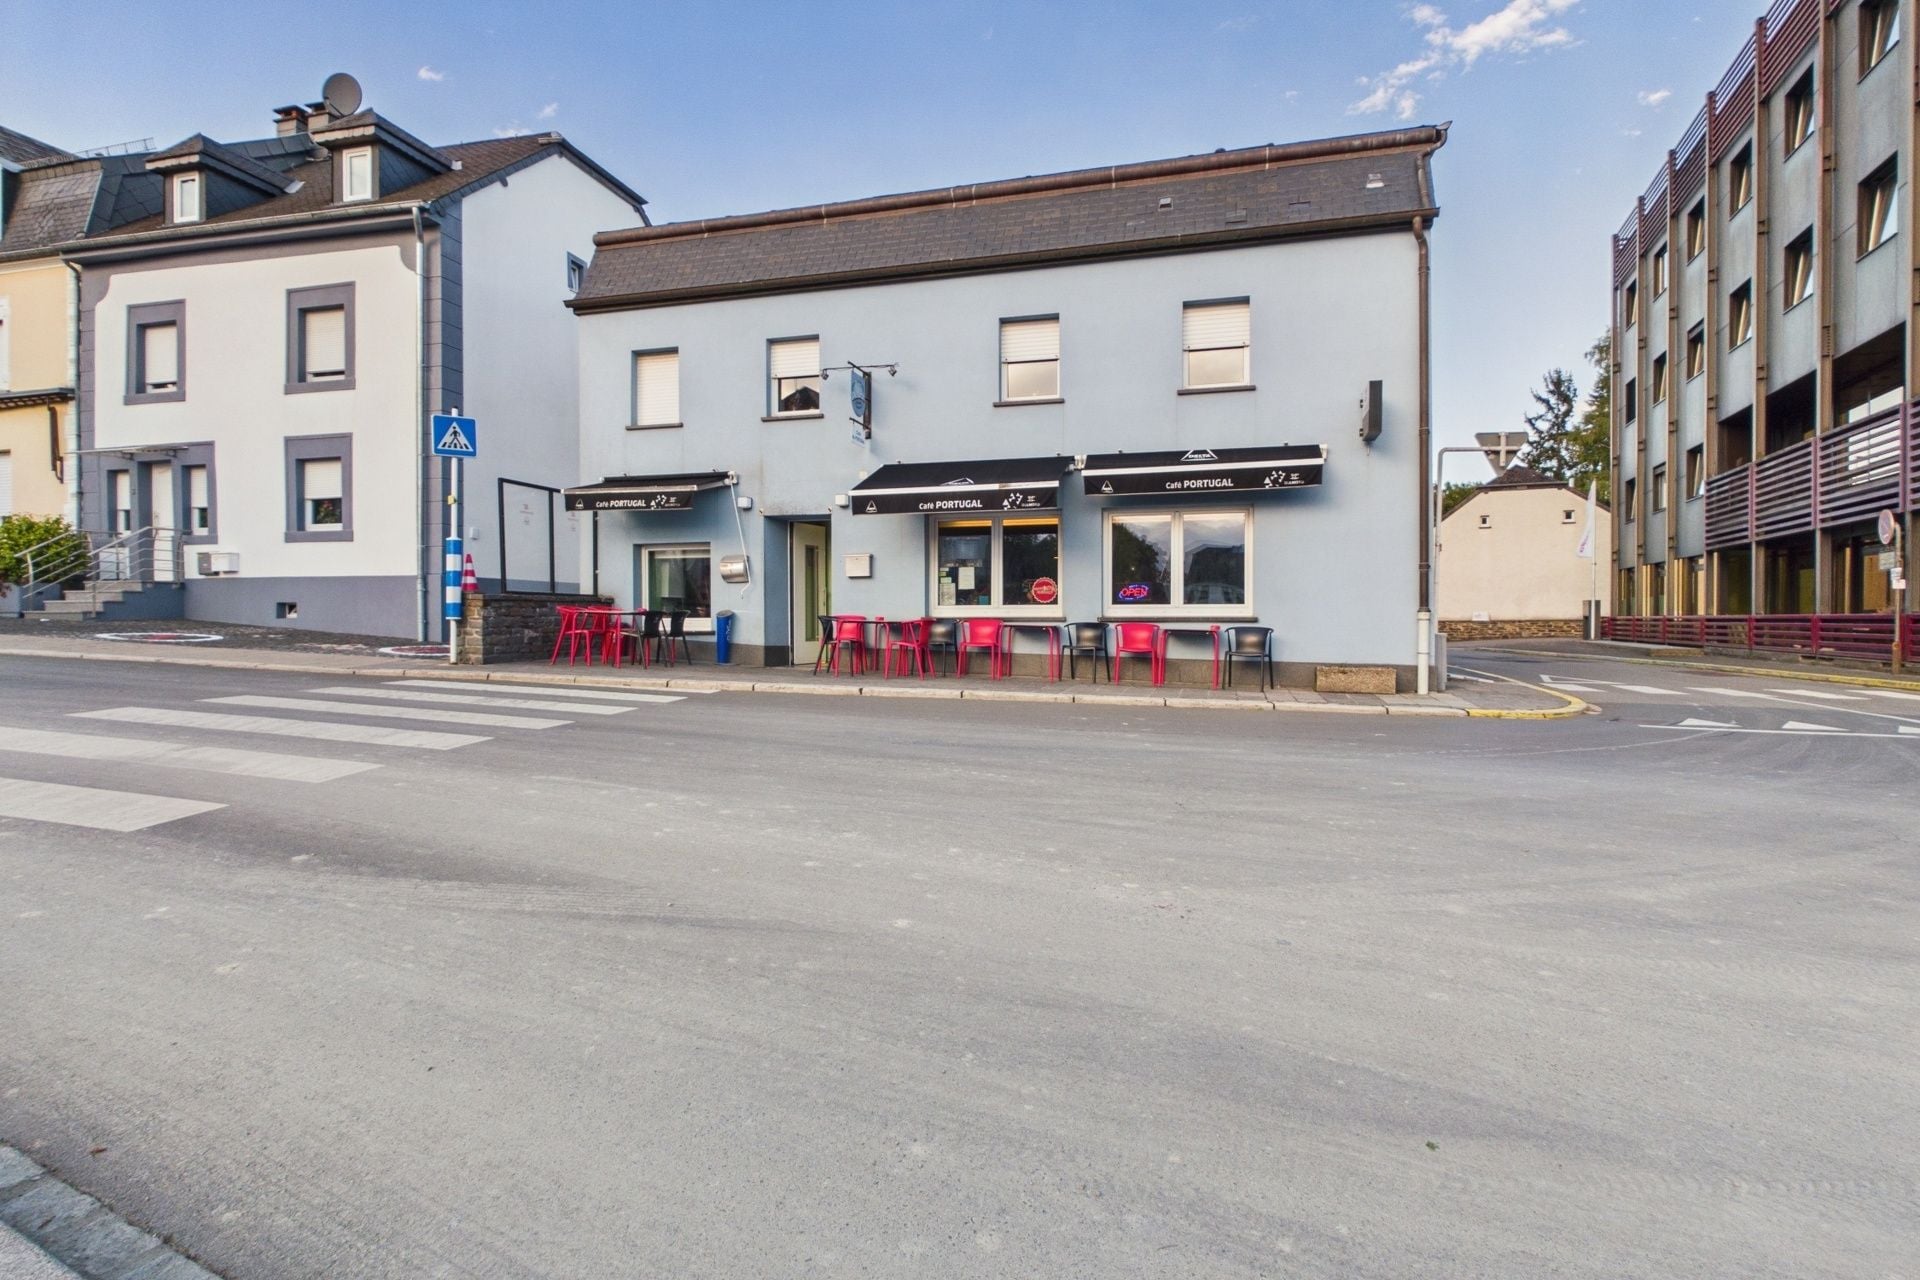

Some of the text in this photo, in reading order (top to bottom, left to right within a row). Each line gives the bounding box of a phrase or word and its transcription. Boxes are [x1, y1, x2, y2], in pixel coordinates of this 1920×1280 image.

[1165, 478, 1234, 489] Café PORTUGAL
[609, 499, 646, 508] PORTUGAL
[935, 499, 983, 509] PORTUGAL
[1121, 588, 1148, 597] OPEN
